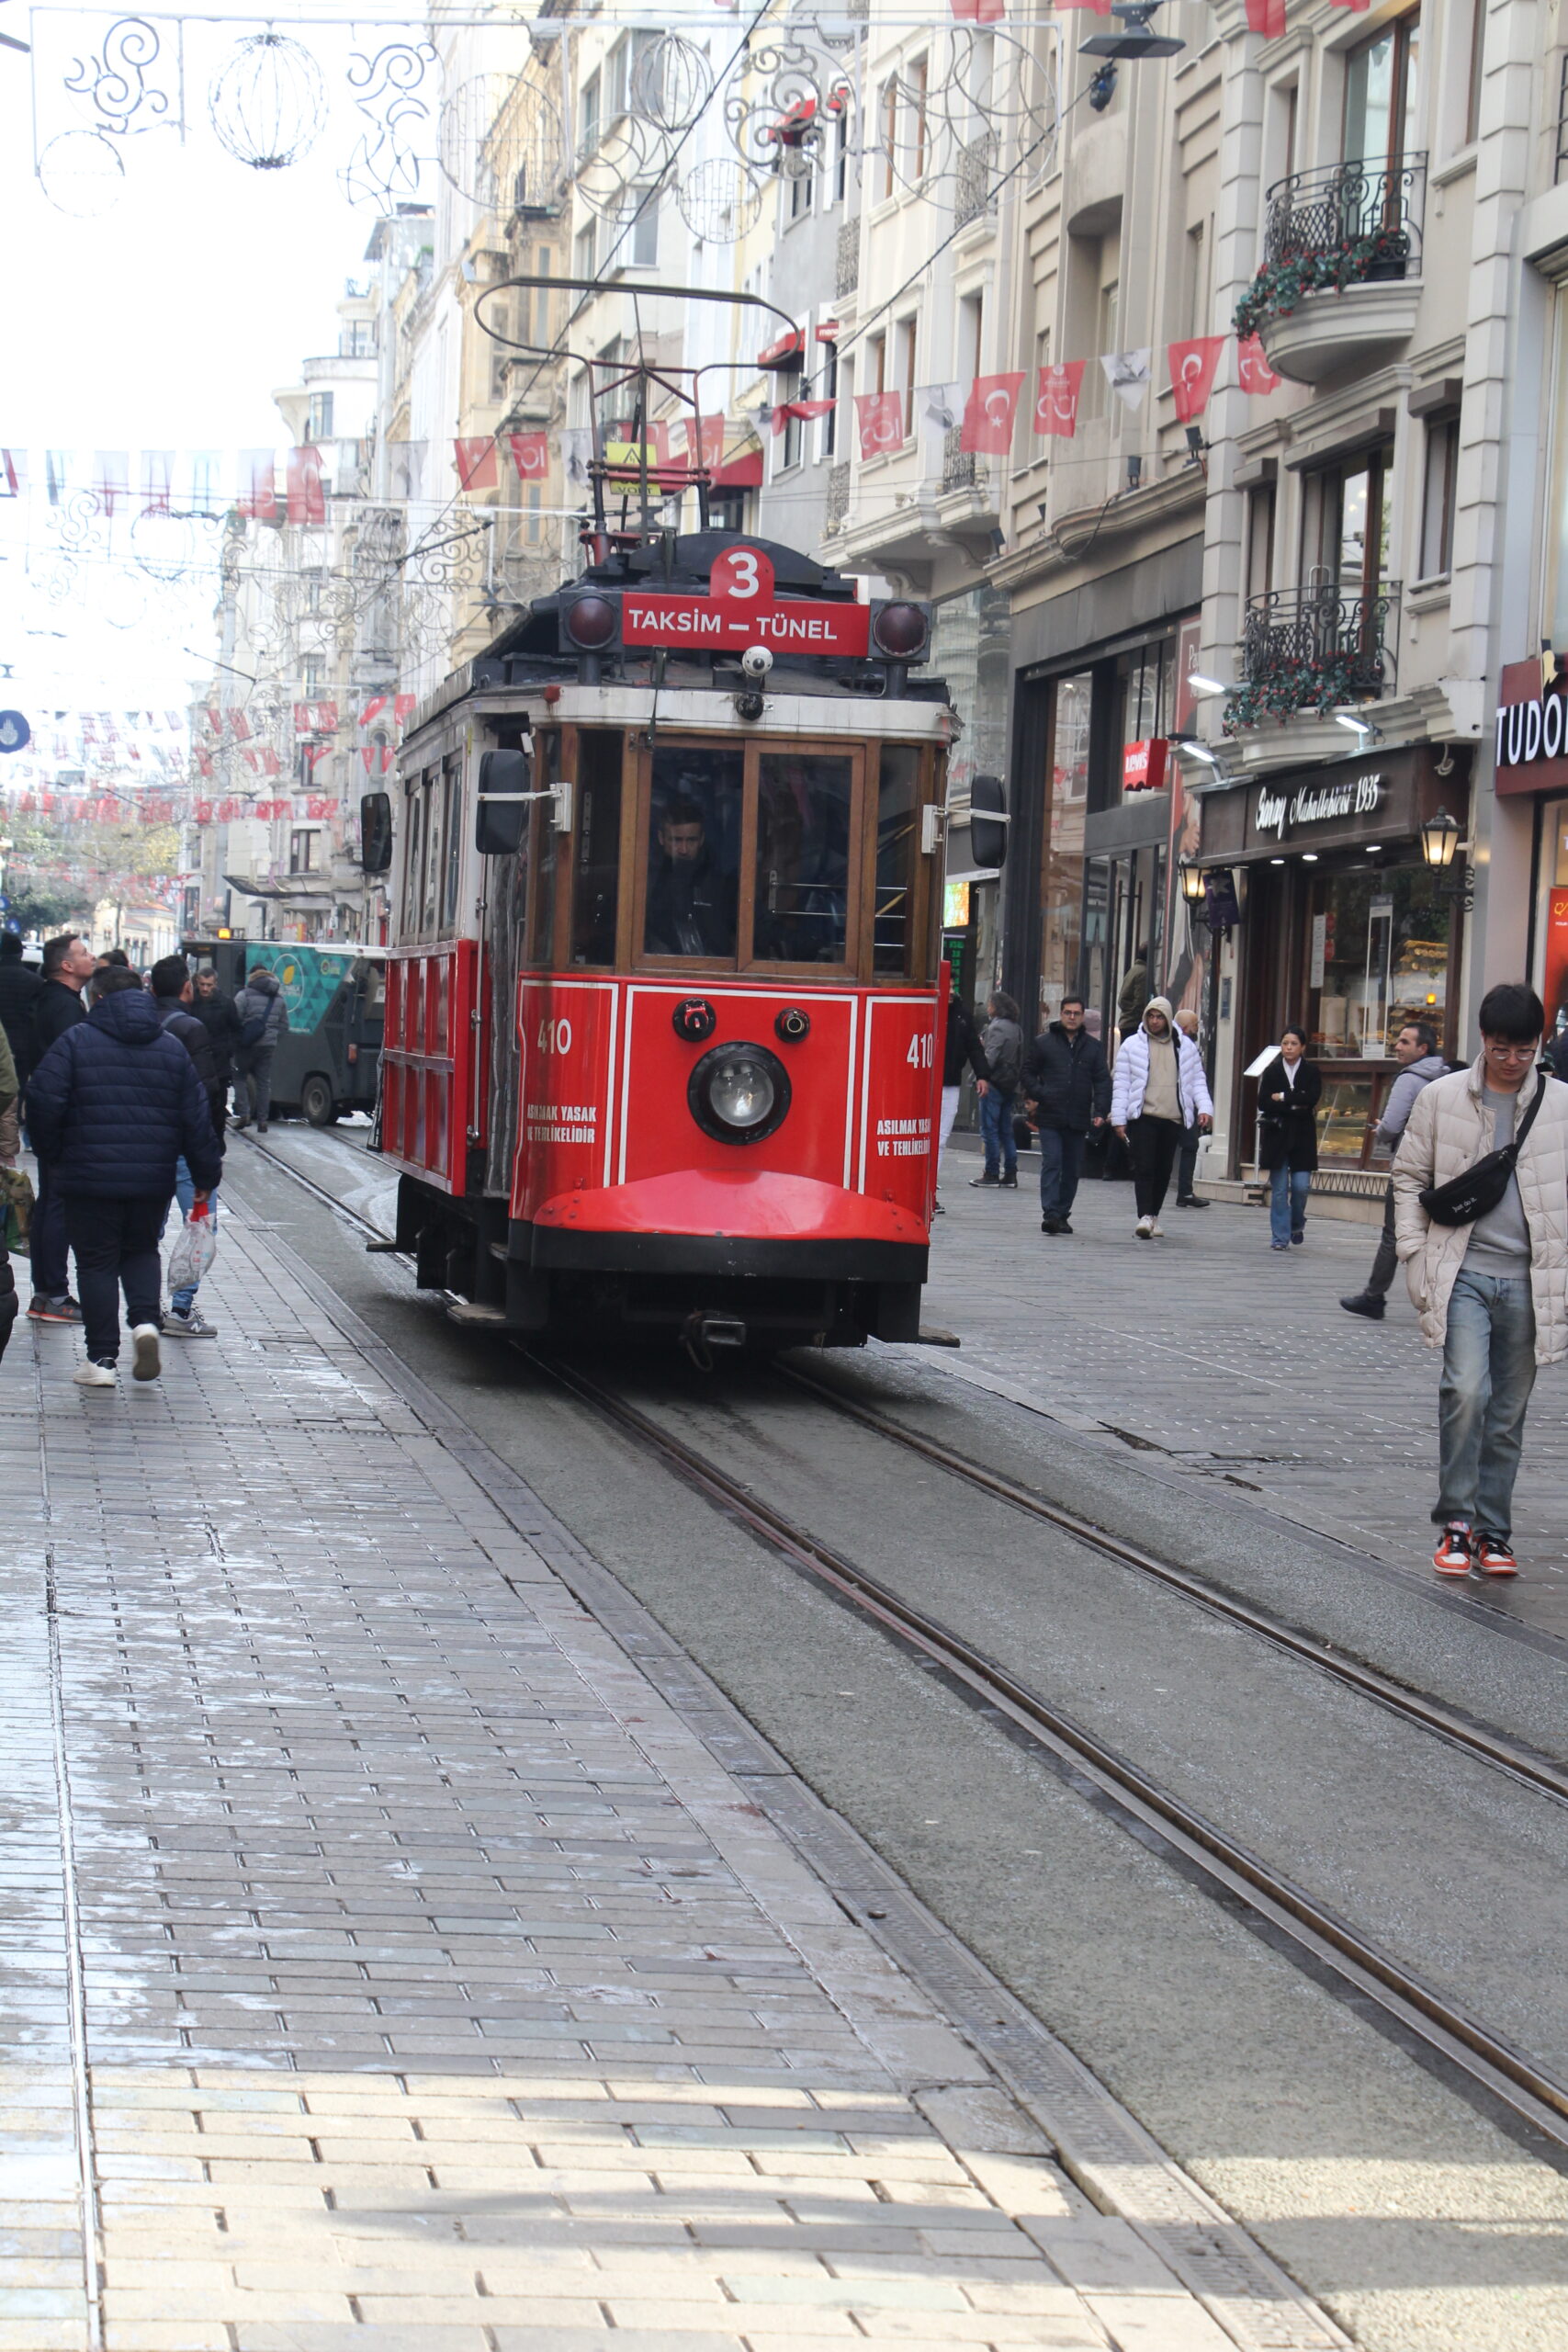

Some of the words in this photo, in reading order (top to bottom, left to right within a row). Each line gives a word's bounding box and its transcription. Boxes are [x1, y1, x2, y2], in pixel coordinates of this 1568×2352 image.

[728, 551, 759, 598] 3
[628, 608, 721, 634] TAKSİM
[756, 613, 837, 640] TÜNEL
[1495, 694, 1568, 766] TUDO
[1355, 774, 1380, 813] 1935
[537, 1018, 572, 1055] 410
[907, 1034, 933, 1069] 410
[561, 1106, 596, 1122] YASAK
[877, 1119, 917, 1135] ASILMAK
[877, 1141, 890, 1156] VE
